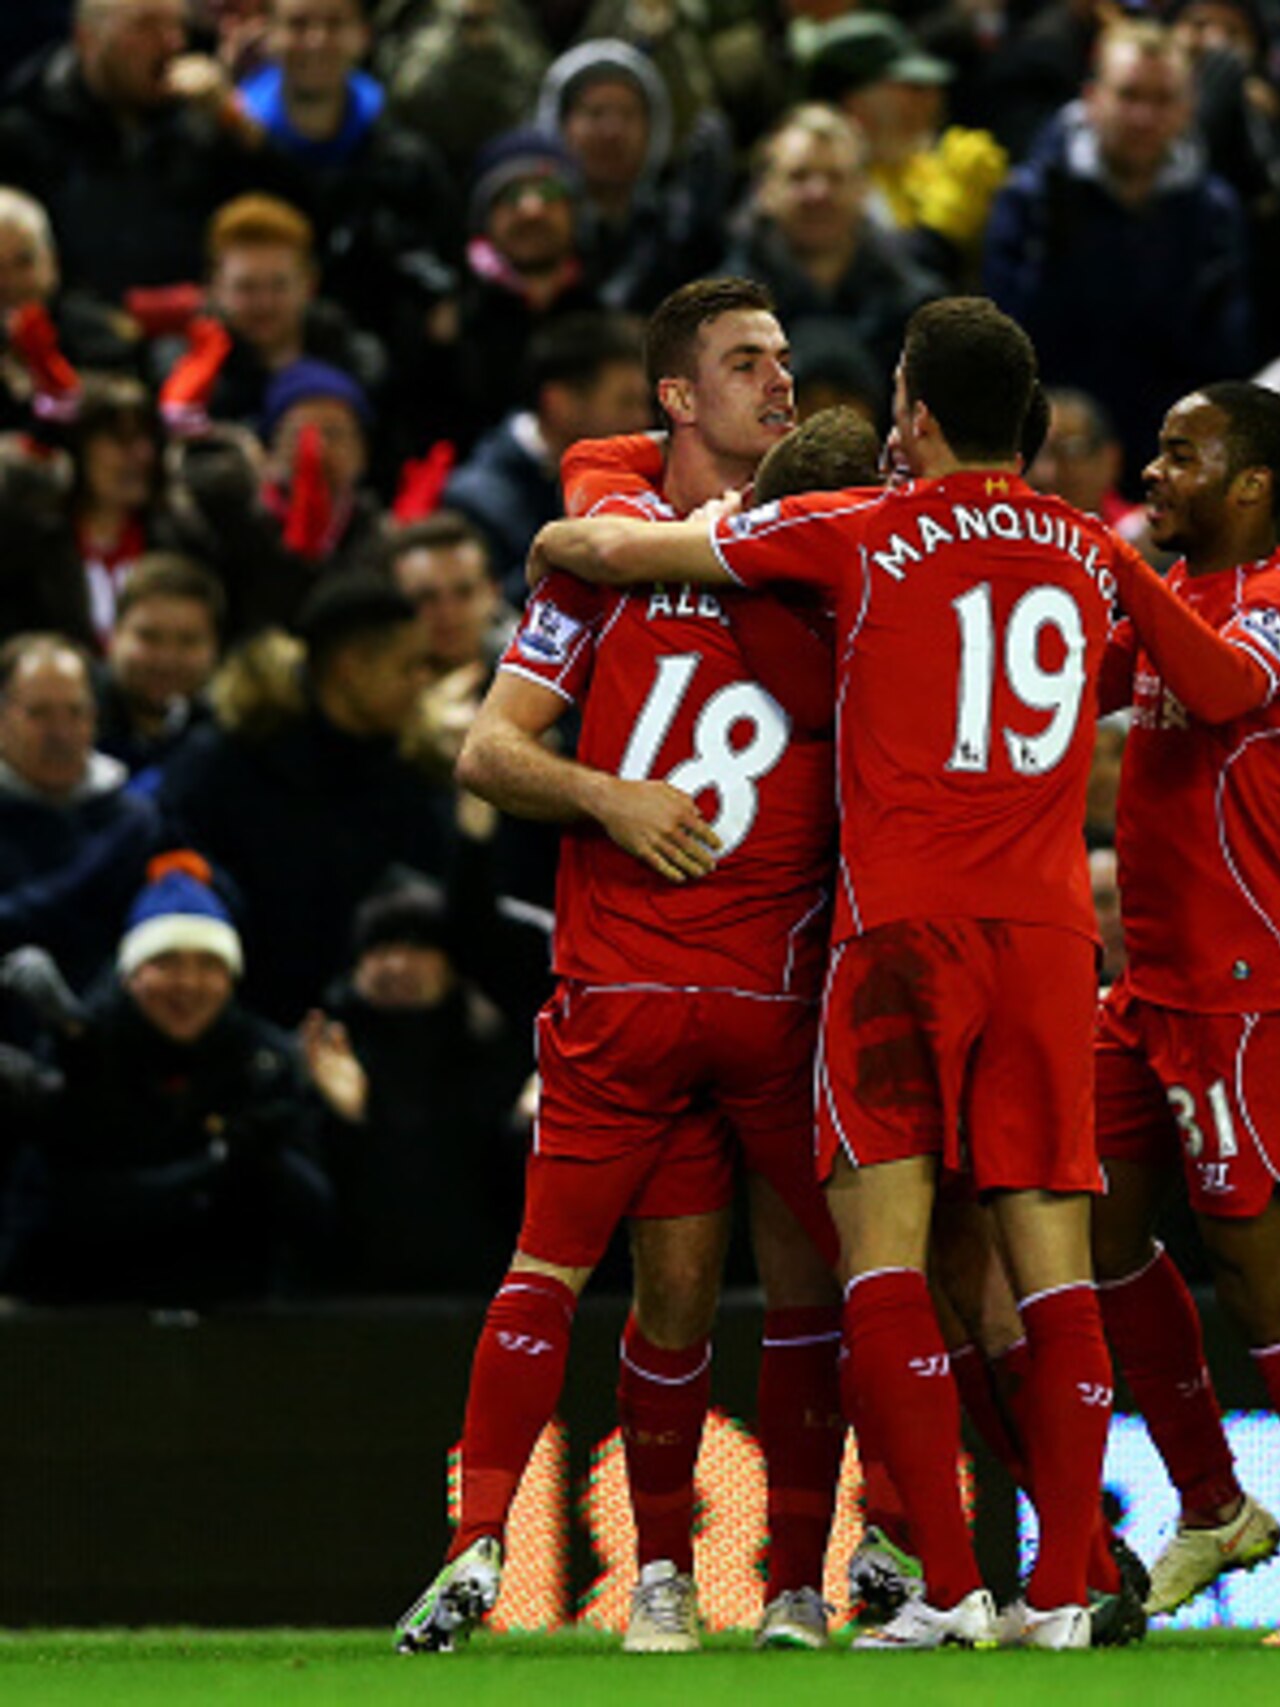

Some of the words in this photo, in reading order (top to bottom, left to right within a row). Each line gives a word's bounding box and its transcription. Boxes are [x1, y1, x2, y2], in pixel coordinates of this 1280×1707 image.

[646, 582, 730, 627] ALB
[871, 502, 1118, 600] MANQUILLO
[944, 580, 1086, 776] 19
[617, 652, 790, 860] 18
